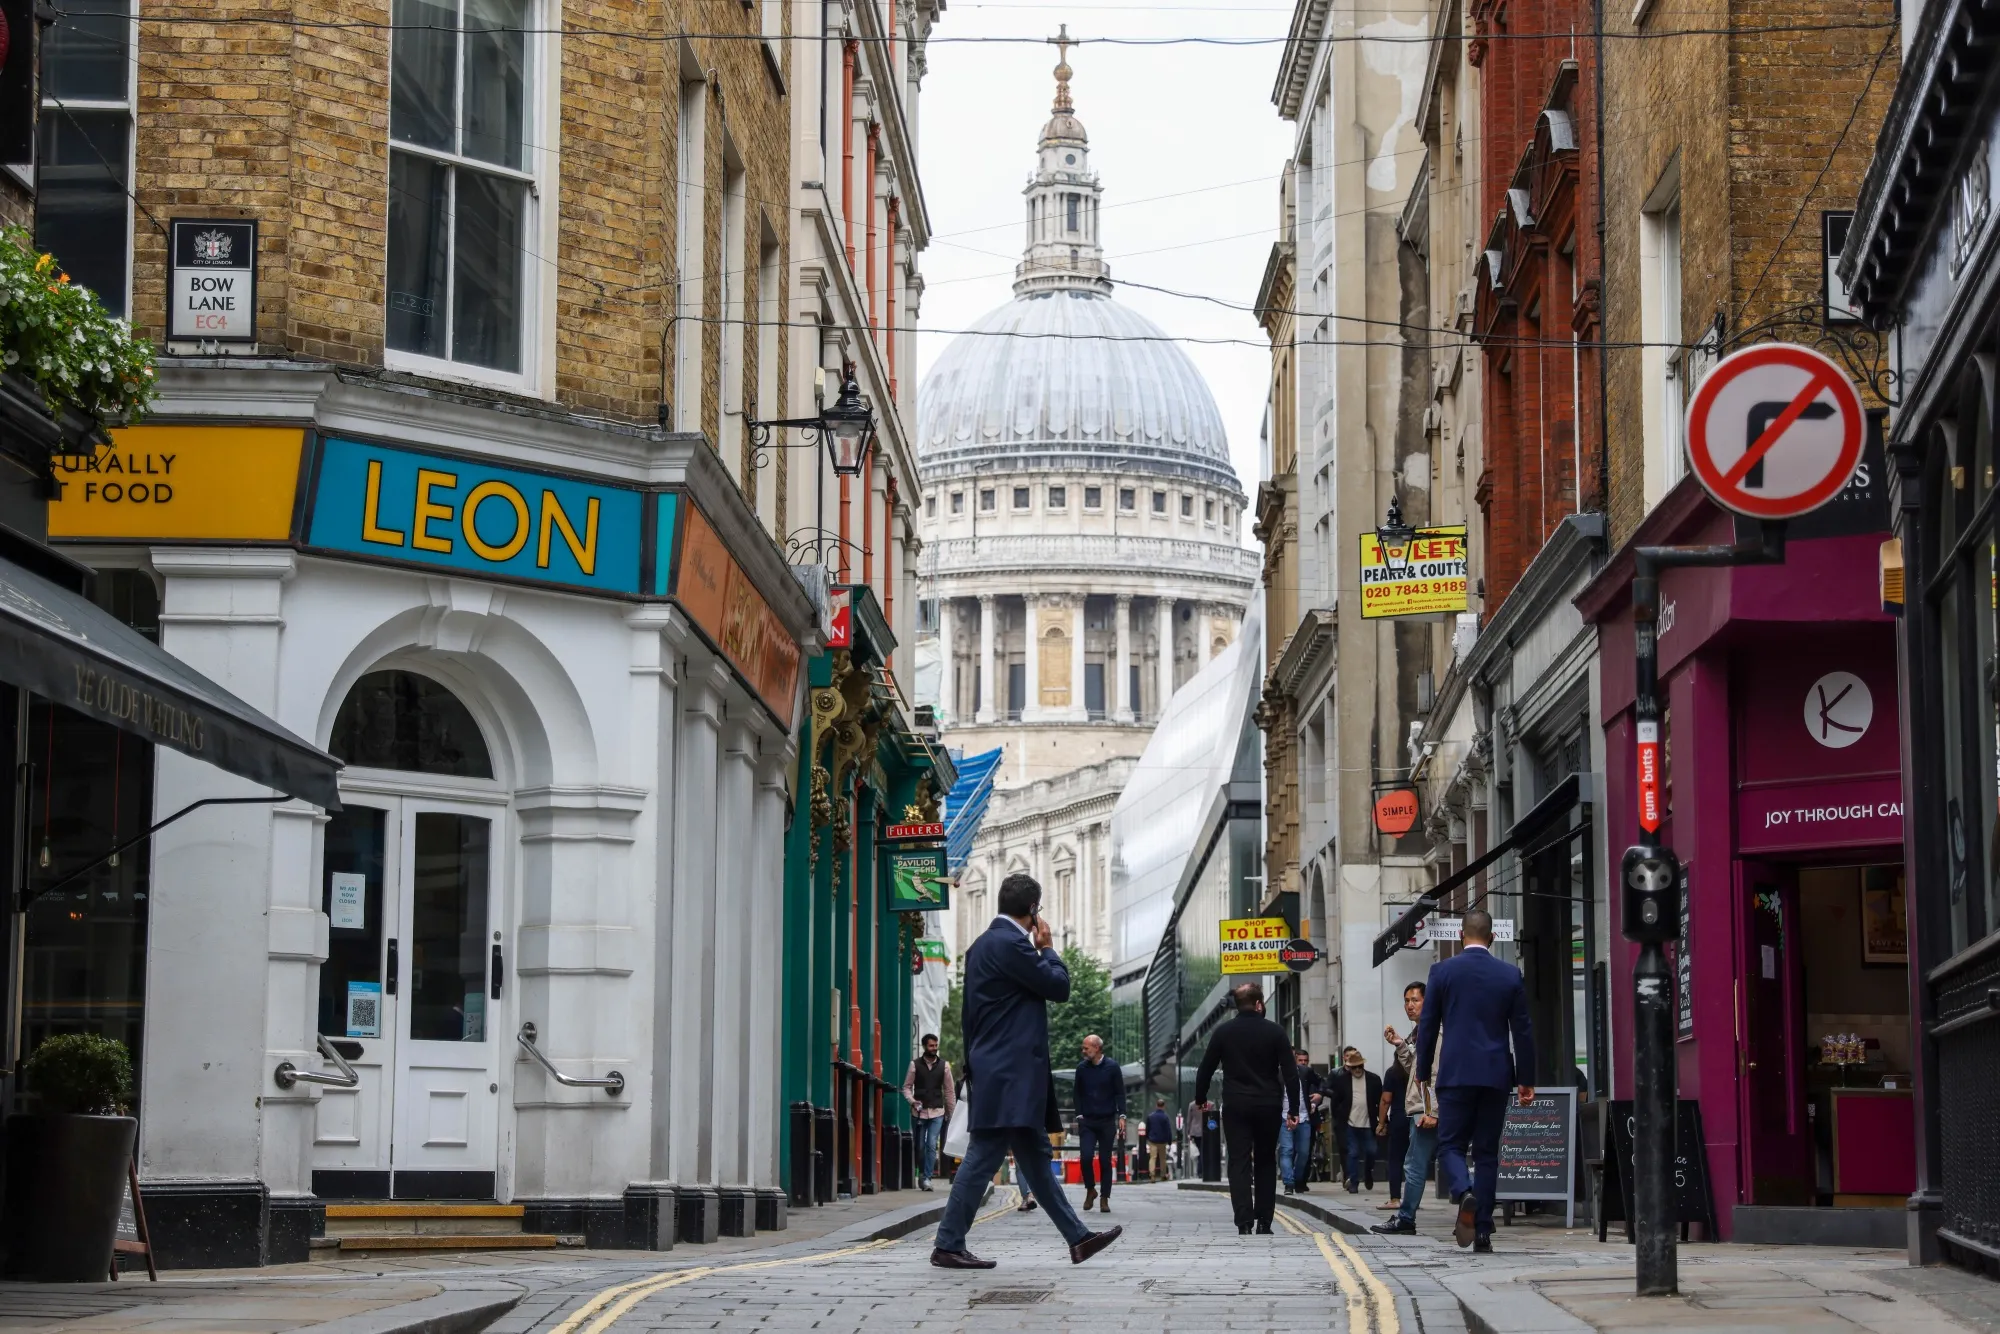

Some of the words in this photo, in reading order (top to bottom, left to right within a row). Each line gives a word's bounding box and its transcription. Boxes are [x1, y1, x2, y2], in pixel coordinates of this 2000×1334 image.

[191, 278, 234, 292] BOW
[189, 296, 235, 311] LANE
[195, 315, 227, 329] EC4
[62, 453, 177, 474] URALLY
[85, 482, 173, 503] FOOD
[362, 459, 602, 576] LEON
[1371, 547, 1403, 563] TO
[1413, 540, 1459, 560] LET
[1407, 565, 1416, 579] &
[1420, 561, 1467, 577] COUTTS
[1366, 586, 1391, 598] 020
[1395, 583, 1429, 596] 7843
[1432, 580, 1467, 593] 9189
[75, 662, 96, 706] YE
[97, 674, 140, 724] OLDE
[143, 693, 204, 751] WATLING
[1817, 683, 1864, 739] K
[1642, 748, 1654, 783] butts
[1382, 805, 1414, 816] SIMPLE
[1645, 791, 1657, 820] gum
[1765, 810, 1792, 828] JOY
[1795, 804, 1873, 823] THROUGH
[897, 859, 936, 868] PAVILION
[1227, 928, 1249, 939] TO
[1254, 926, 1283, 938] LET
[1429, 929, 1457, 938] FRESH
[1494, 931, 1511, 939] NLY
[1222, 941, 1249, 951] PEARL
[1250, 941, 1257, 950] &
[1223, 954, 1240, 962] 020
[1243, 953, 1265, 961] 7843
[1267, 952, 1278, 960] 91
